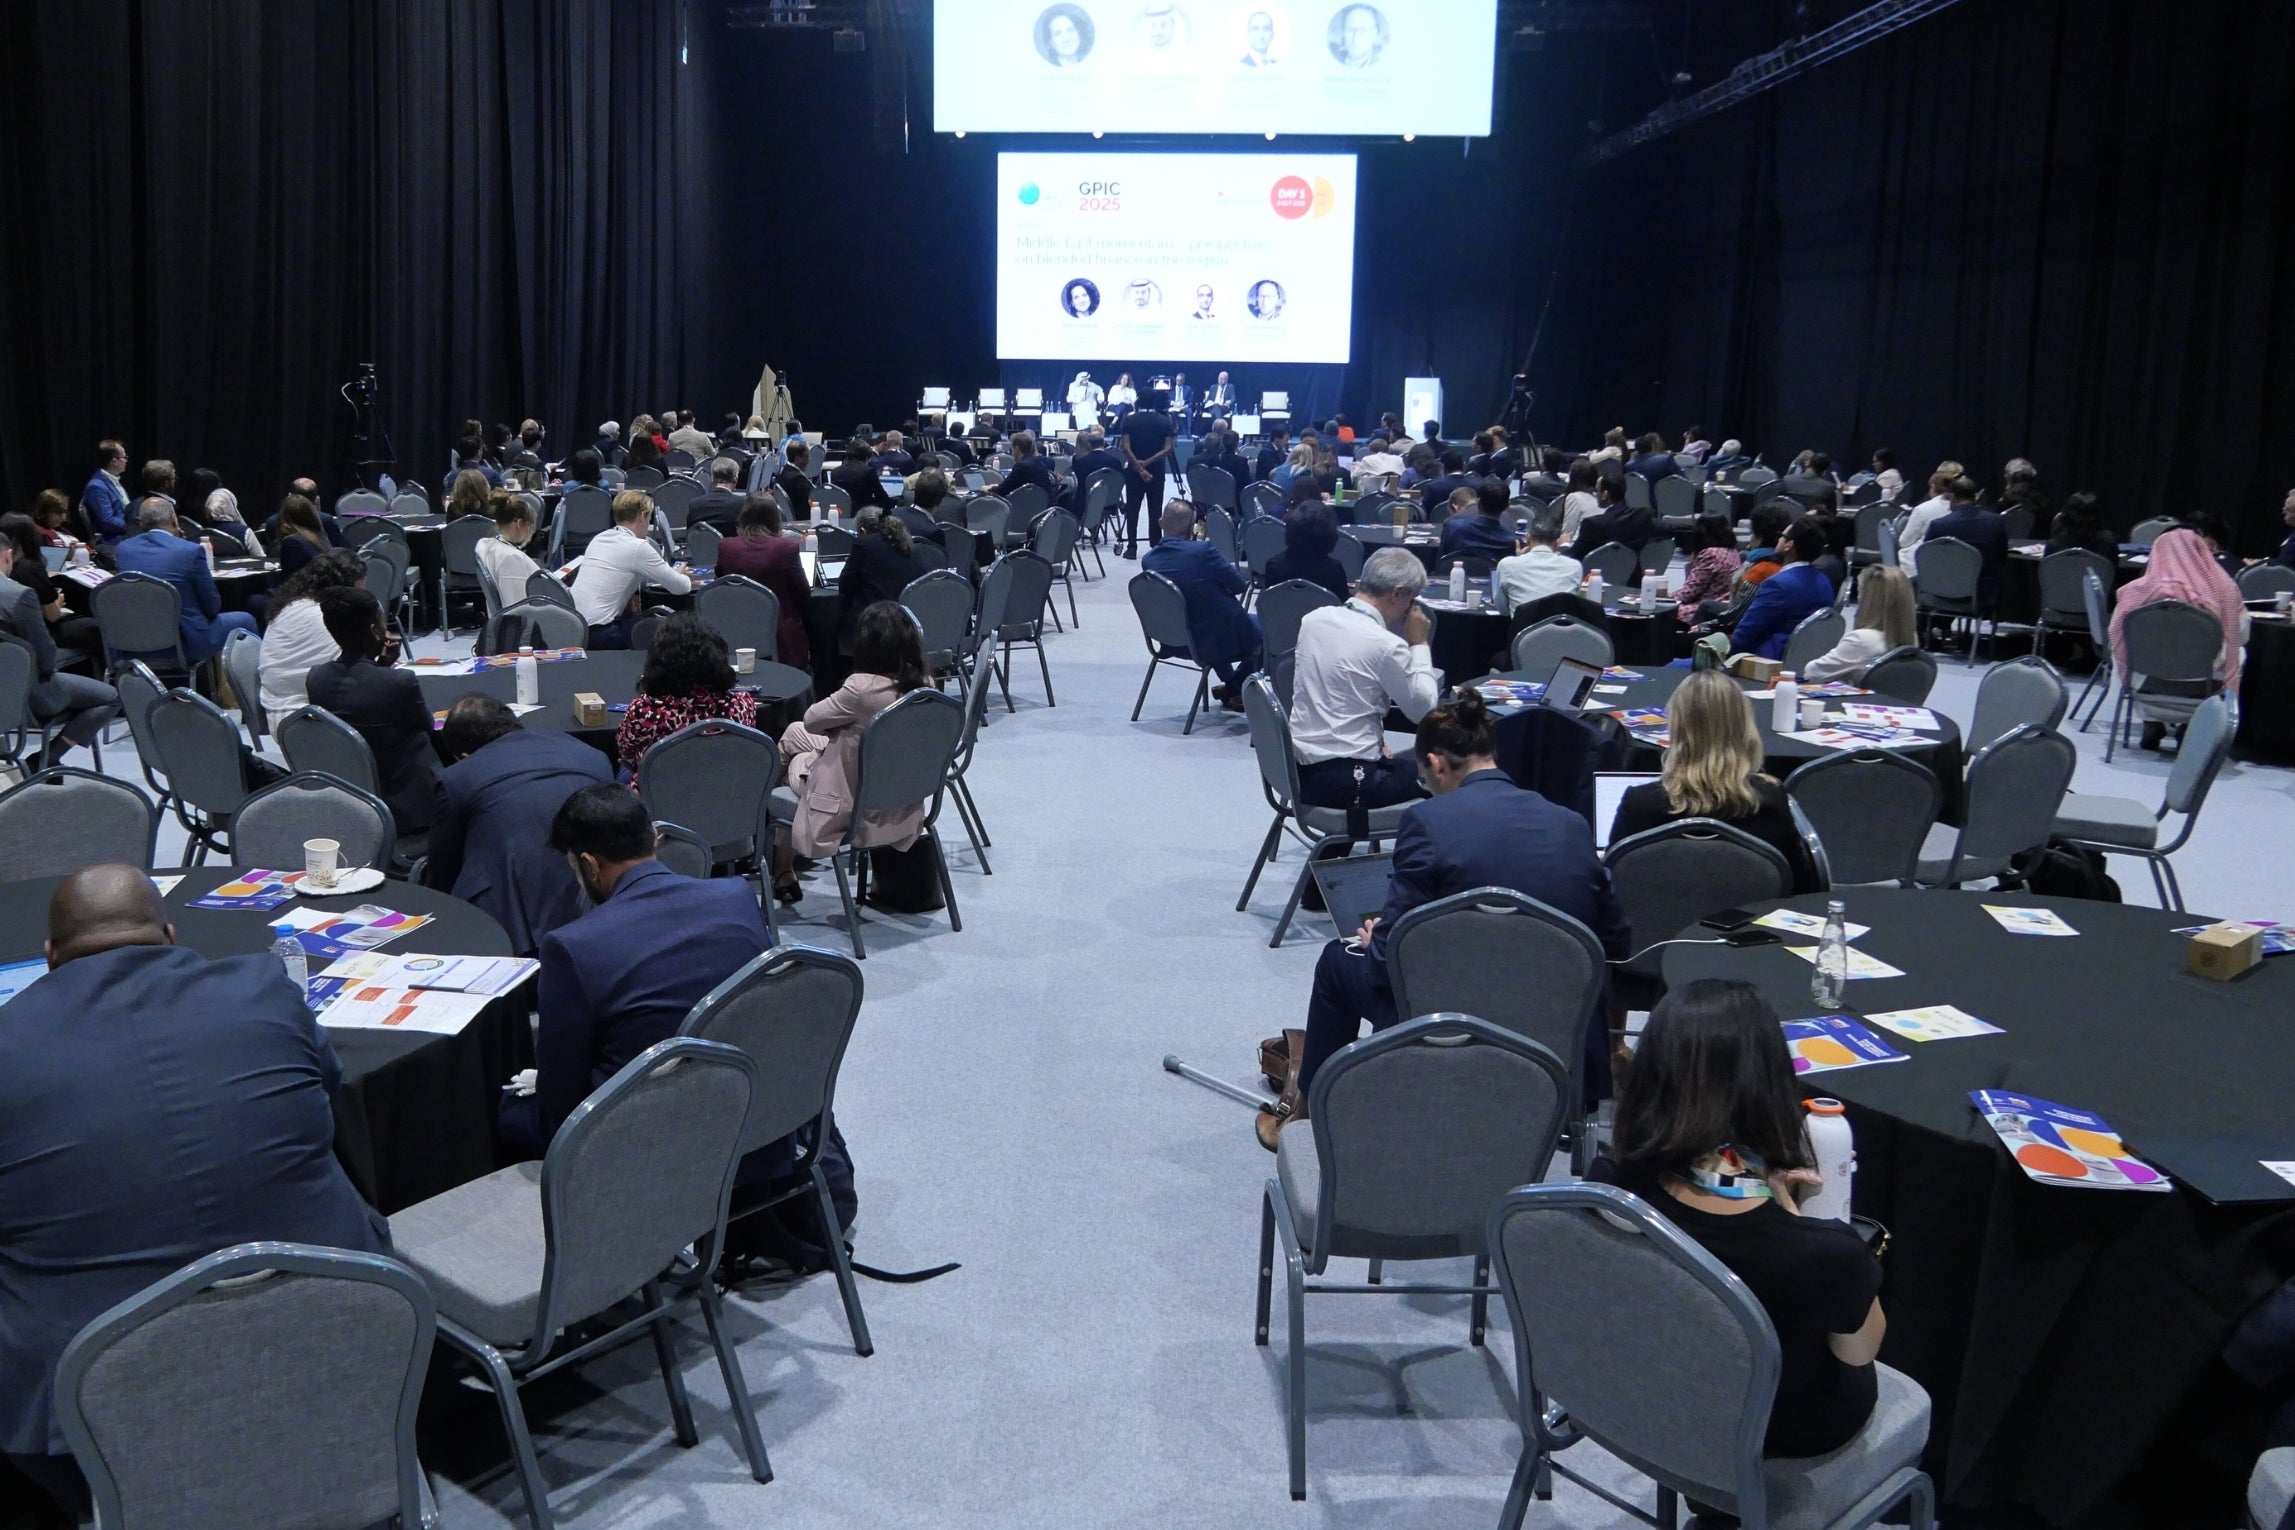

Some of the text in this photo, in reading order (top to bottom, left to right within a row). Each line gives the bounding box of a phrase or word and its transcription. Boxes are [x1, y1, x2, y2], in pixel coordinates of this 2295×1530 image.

[1079, 181, 1121, 196] GPIC
[1278, 188, 1298, 199] DAY
[1299, 188, 1306, 199] 1
[1079, 197, 1121, 211] 2025
[1017, 236, 1061, 249] Middle
[1016, 255, 1035, 265] on
[1037, 252, 1092, 265] blended
